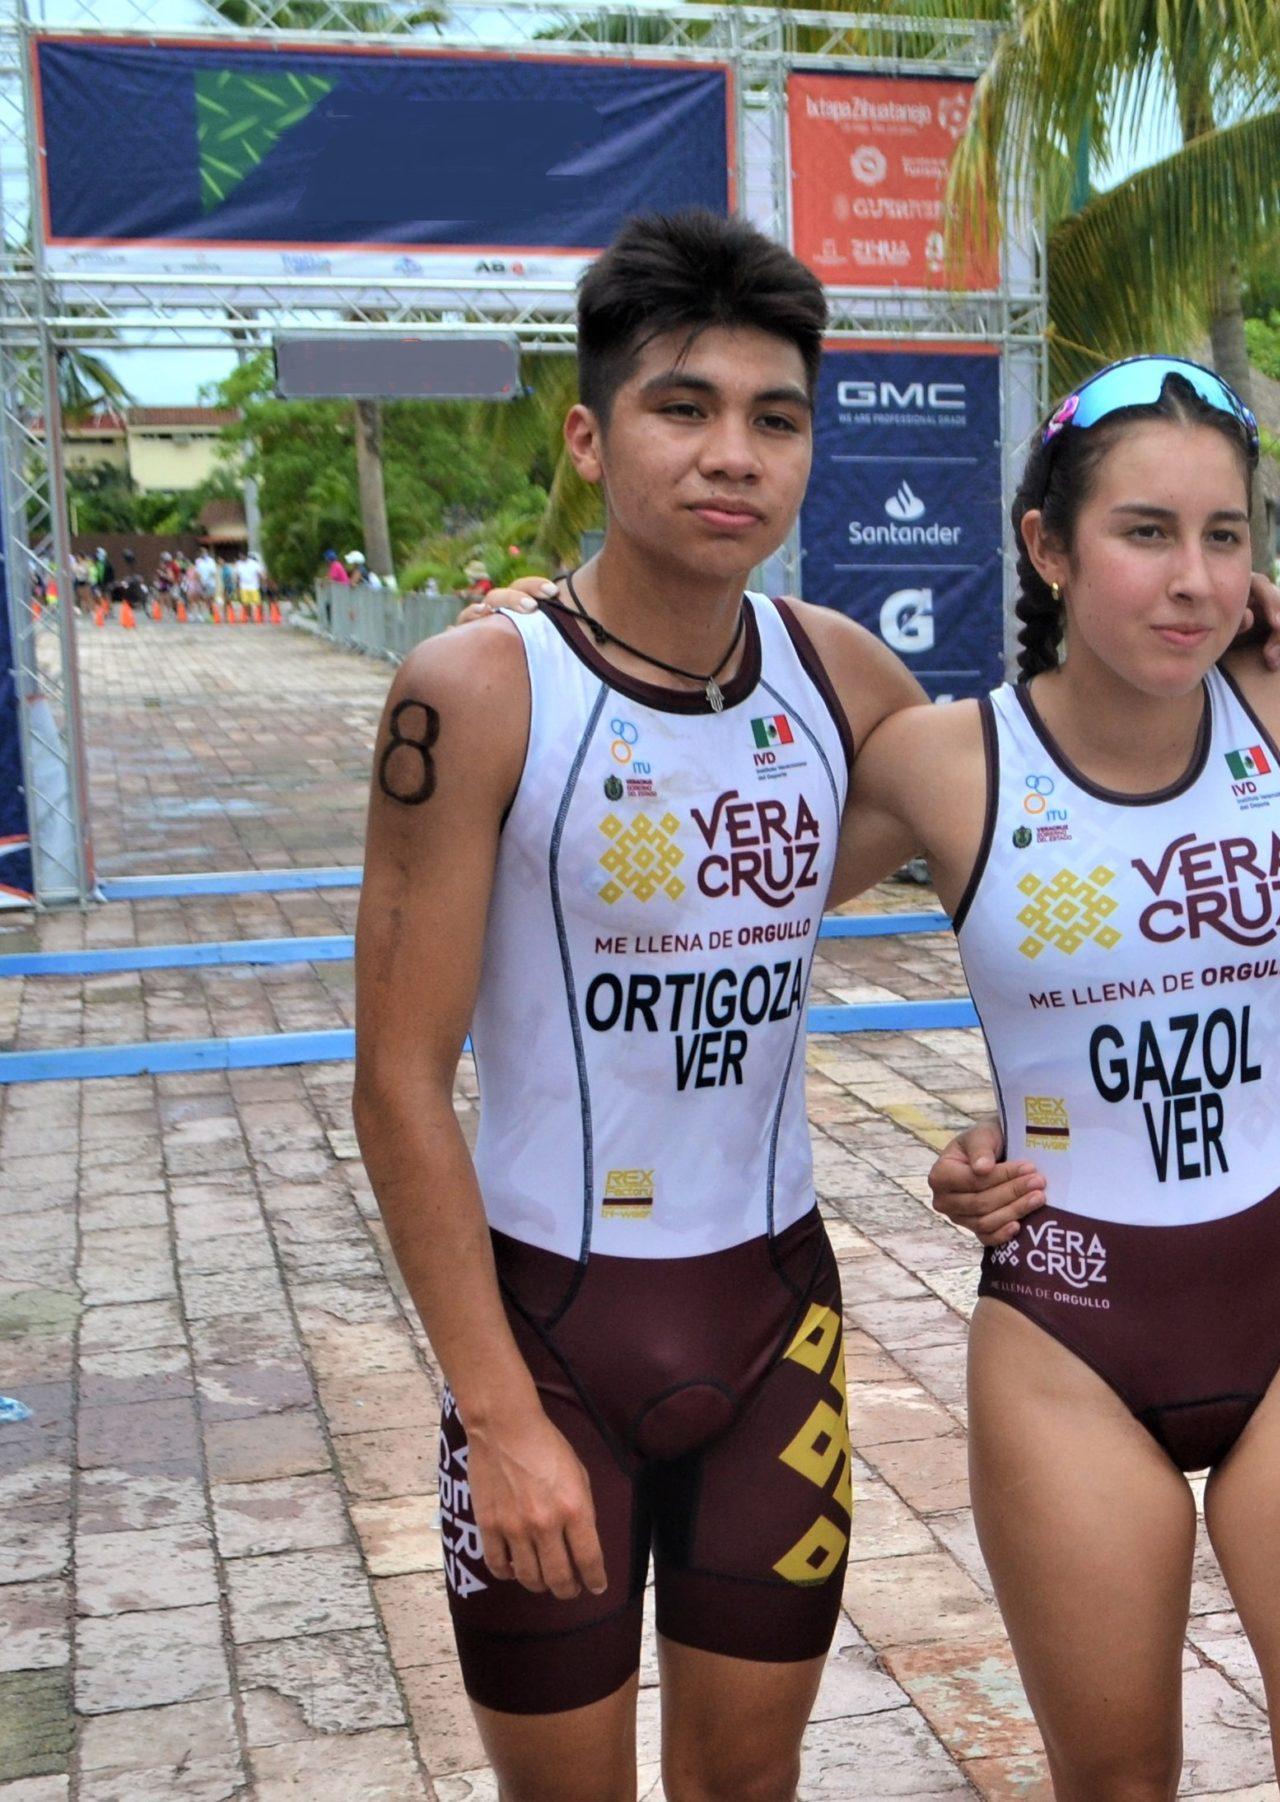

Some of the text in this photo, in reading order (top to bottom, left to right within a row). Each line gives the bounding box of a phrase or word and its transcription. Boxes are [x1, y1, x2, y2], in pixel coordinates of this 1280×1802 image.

[837, 381, 966, 409] GMC
[848, 521, 962, 545] Santander
[880, 588, 935, 653] G
[379, 698, 440, 805] 8
[633, 762, 651, 774] ITU
[753, 752, 776, 766] IVD
[1231, 781, 1257, 797] IVD
[690, 790, 820, 850] VERA
[1047, 809, 1068, 821] ITU
[697, 842, 820, 908] CRUZ
[595, 918, 811, 954] ME LLENA DE ORGULLO
[585, 957, 803, 1032] ORTIGOZA
[1029, 991, 1066, 1010] ME
[1073, 978, 1154, 1006] LLENA
[1163, 970, 1195, 993] DE
[675, 1029, 748, 1091] VER
[1089, 1004, 1263, 1103] GAZOL
[1024, 1096, 1066, 1114] REX
[1142, 1092, 1230, 1183] VER
[607, 1170, 655, 1186] REX
[1026, 1220, 1106, 1258] VERA
[1026, 1249, 1107, 1288] CRUZ
[1035, 1287, 1052, 1299] DE
[1053, 1291, 1110, 1309] ORGULLO
